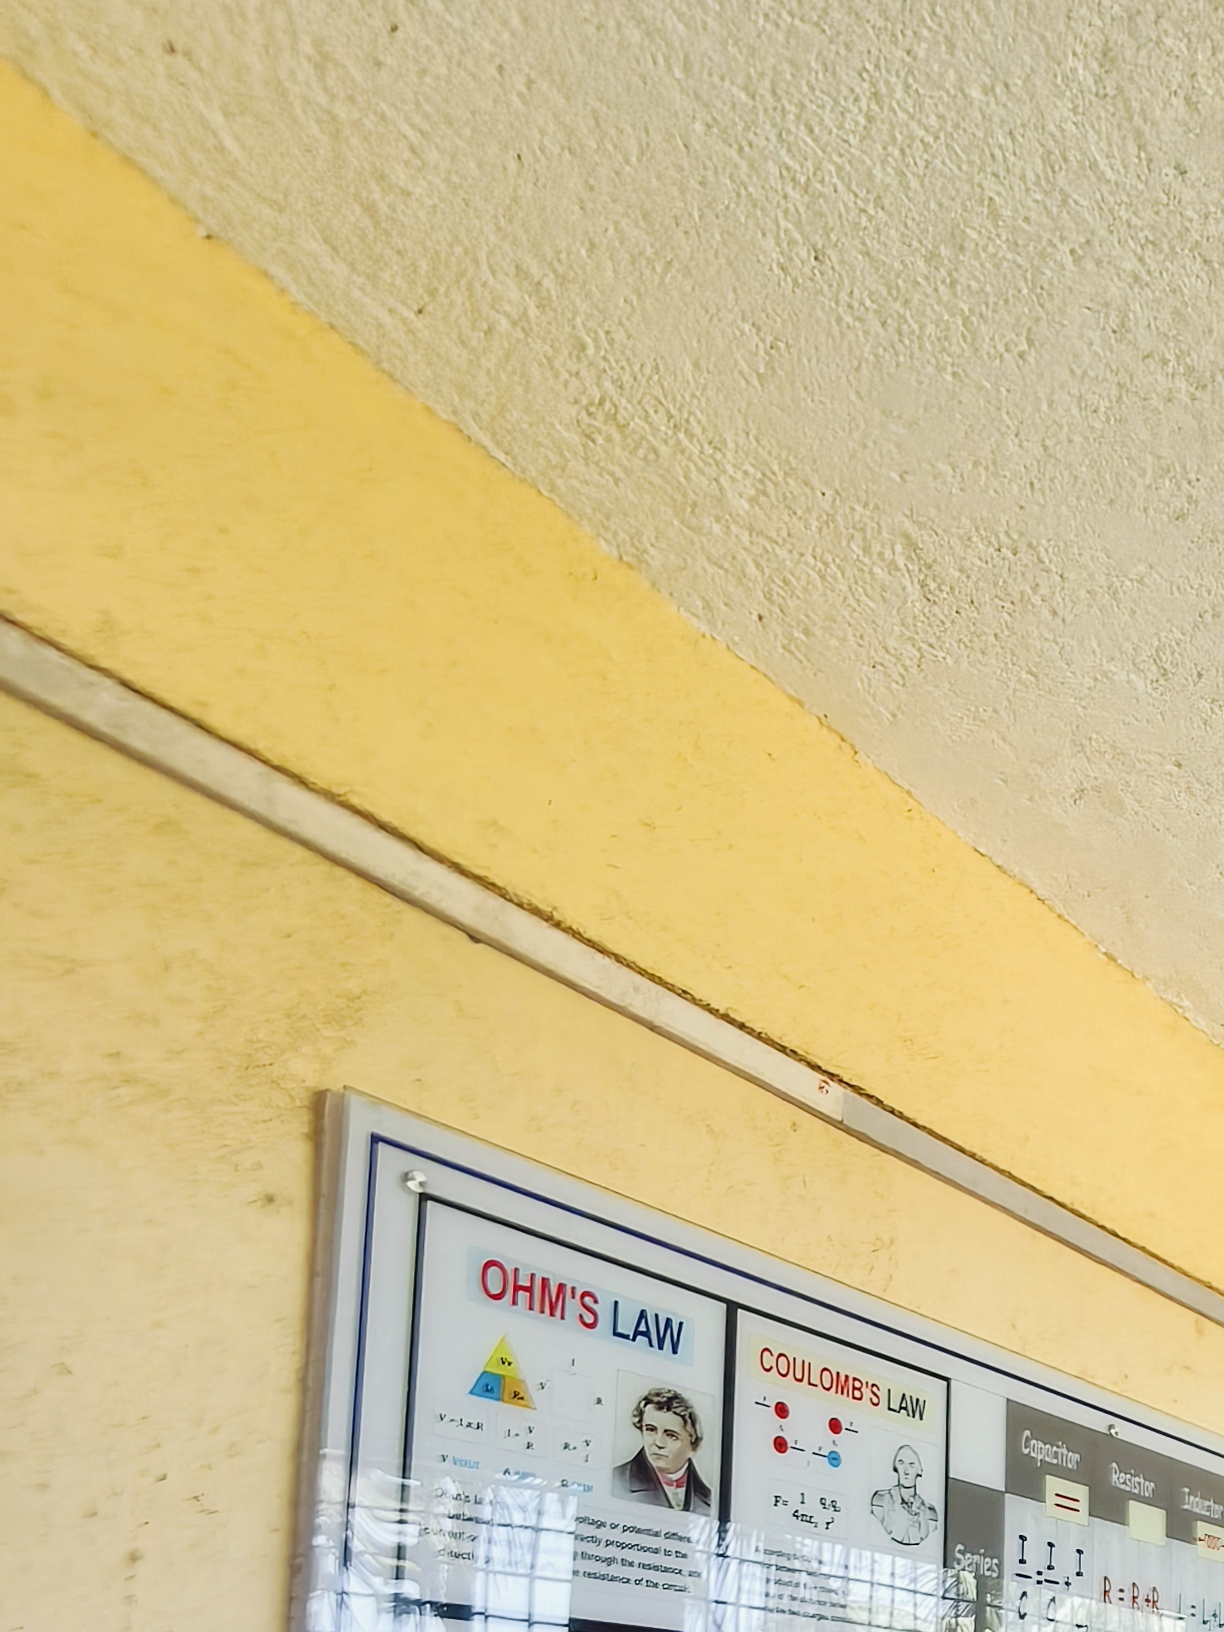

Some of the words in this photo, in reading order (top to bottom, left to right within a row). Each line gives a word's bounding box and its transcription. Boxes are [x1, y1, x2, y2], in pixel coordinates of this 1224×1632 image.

[481, 1260, 598, 1330] OHM'S
[612, 1300, 684, 1355] LAW
[759, 1347, 880, 1407] COULOMB'S
[887, 1388, 927, 1422] LAW
[1021, 1429, 1081, 1470] Capacitor
[1110, 1462, 1156, 1498] Resistor
[1181, 1487, 1224, 1520] Inductor
[622, 1524, 661, 1538] potential
[581, 1551, 618, 1566] through
[621, 1557, 635, 1567] the
[605, 1539, 661, 1554] proportional
[664, 1548, 672, 1557] to
[675, 1551, 688, 1559] the
[953, 1544, 999, 1578] Series
[583, 1571, 632, 1584] resistance
[646, 1580, 660, 1588] the
